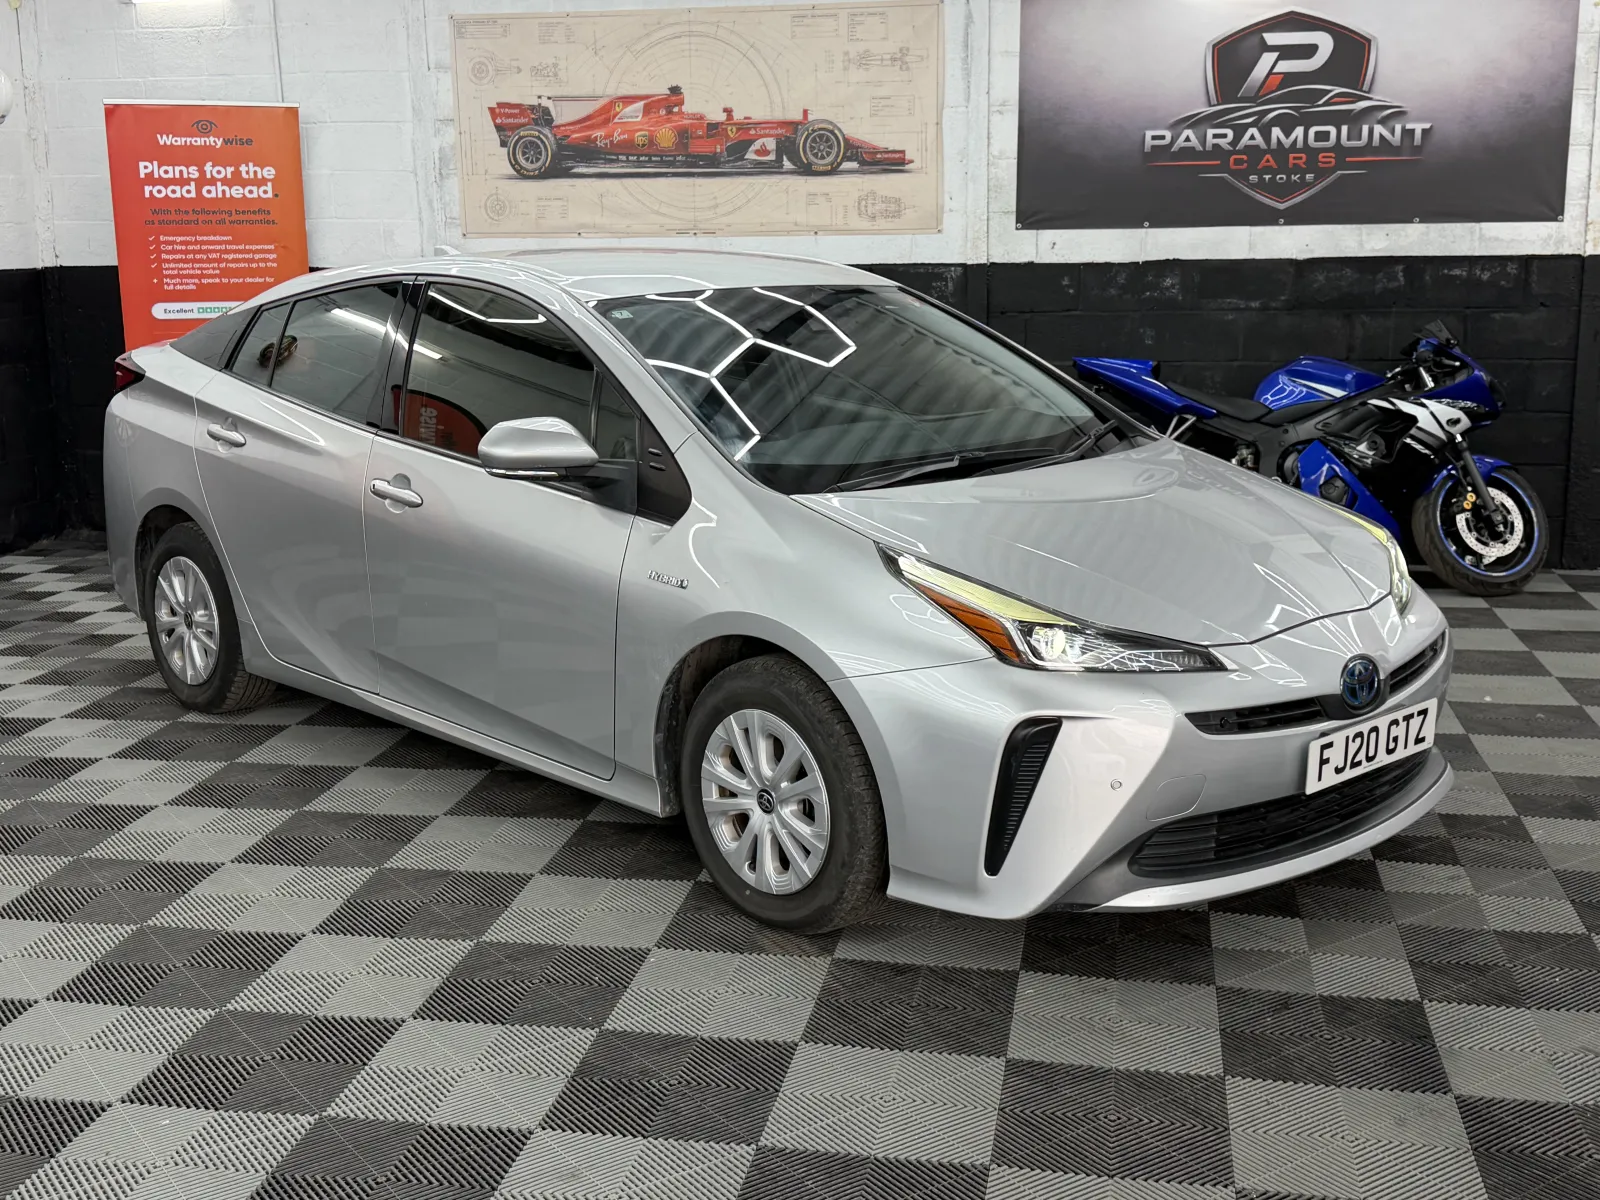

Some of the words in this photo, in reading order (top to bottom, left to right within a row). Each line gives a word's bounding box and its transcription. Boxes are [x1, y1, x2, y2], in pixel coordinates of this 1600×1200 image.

[592, 128, 628, 148] Ray-Ban
[756, 127, 786, 135] Santander
[1144, 122, 1432, 152] PARAMOUNT
[156, 133, 254, 148] Warrantywise
[1229, 153, 1337, 170] CARS
[138, 160, 200, 179] Plans
[204, 161, 235, 179] for
[239, 161, 276, 179] the
[1248, 174, 1315, 184] STOKE
[144, 181, 197, 198] road
[201, 181, 279, 198] ahead.
[150, 208, 172, 216] With
[174, 208, 190, 216] the
[191, 208, 233, 217] following
[234, 208, 271, 216] benefits
[158, 218, 199, 226] standard
[228, 218, 278, 226] warranties.
[221, 252, 253, 260] registered
[226, 261, 249, 269] repairs
[1317, 725, 1380, 783] FJ20
[1385, 707, 1429, 756] GTZ
